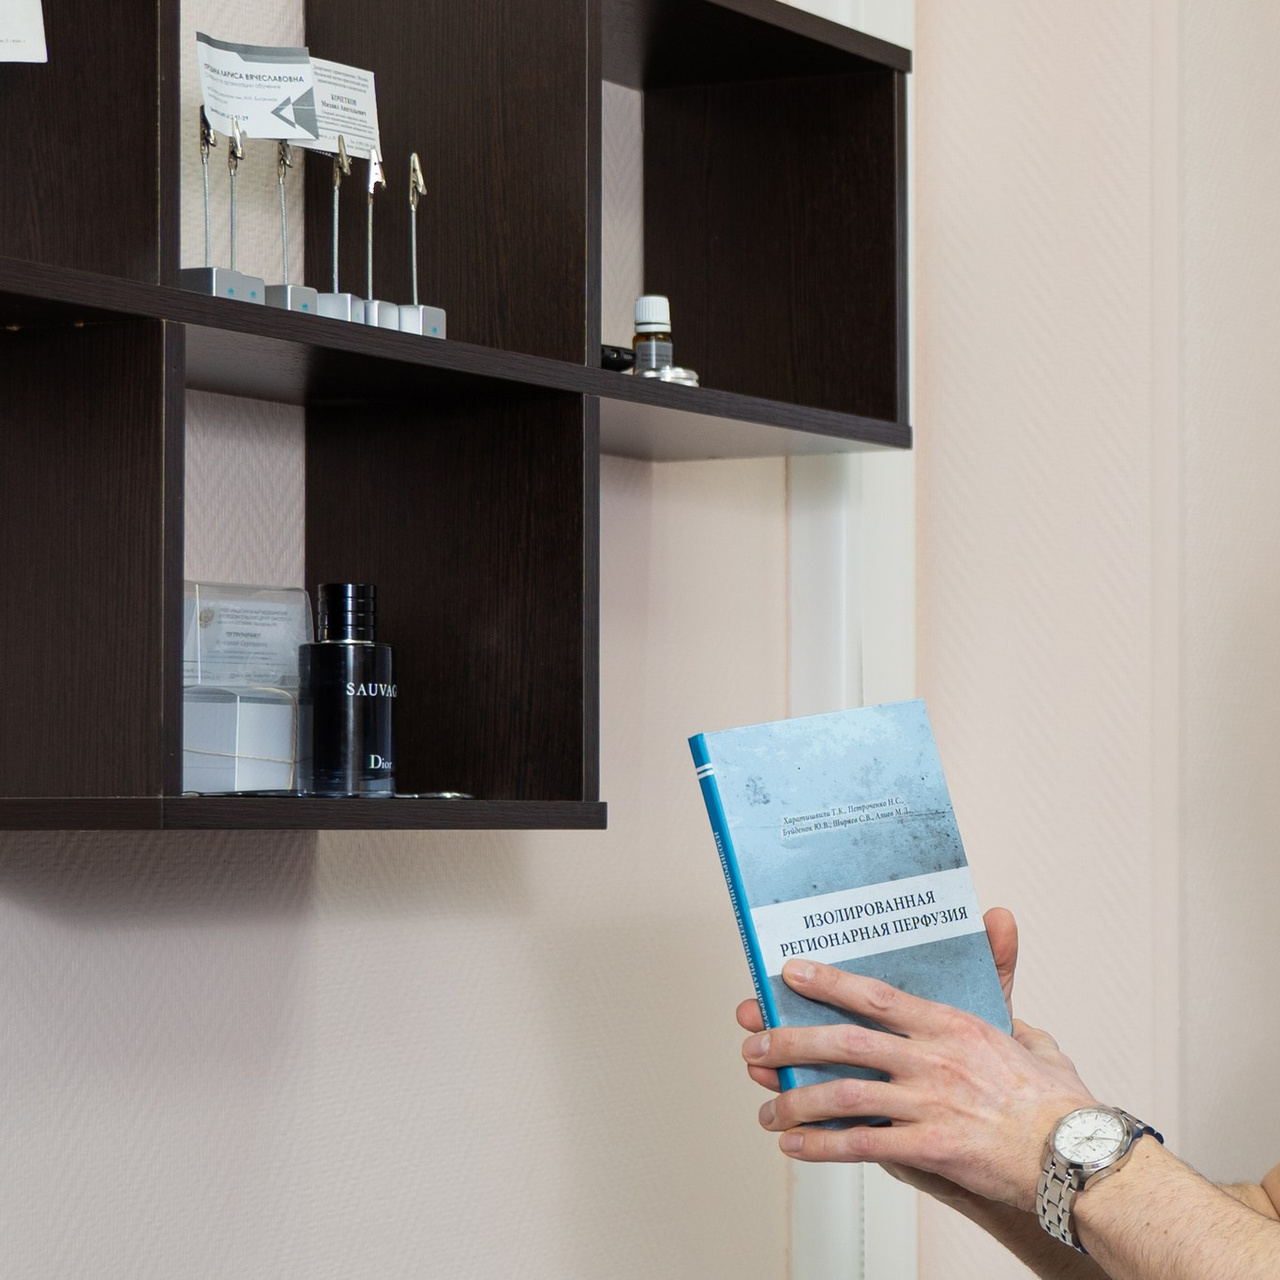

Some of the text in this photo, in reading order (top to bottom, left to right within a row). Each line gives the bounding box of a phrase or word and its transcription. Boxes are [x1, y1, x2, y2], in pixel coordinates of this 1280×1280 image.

[245, 73, 305, 83] ВЯЧЕСЛАВОВНА
[369, 753, 392, 770] Dior
[714, 831, 741, 918] ИЗОЛИРОВАННАЯ
[737, 918, 760, 988] РЕГИОНАРНАЯ
[803, 890, 936, 930] ИЗОЛИРОВАННАЯ
[780, 906, 969, 958] РЕГИОНАРНАЯ ПЕРФУЗИЯ
